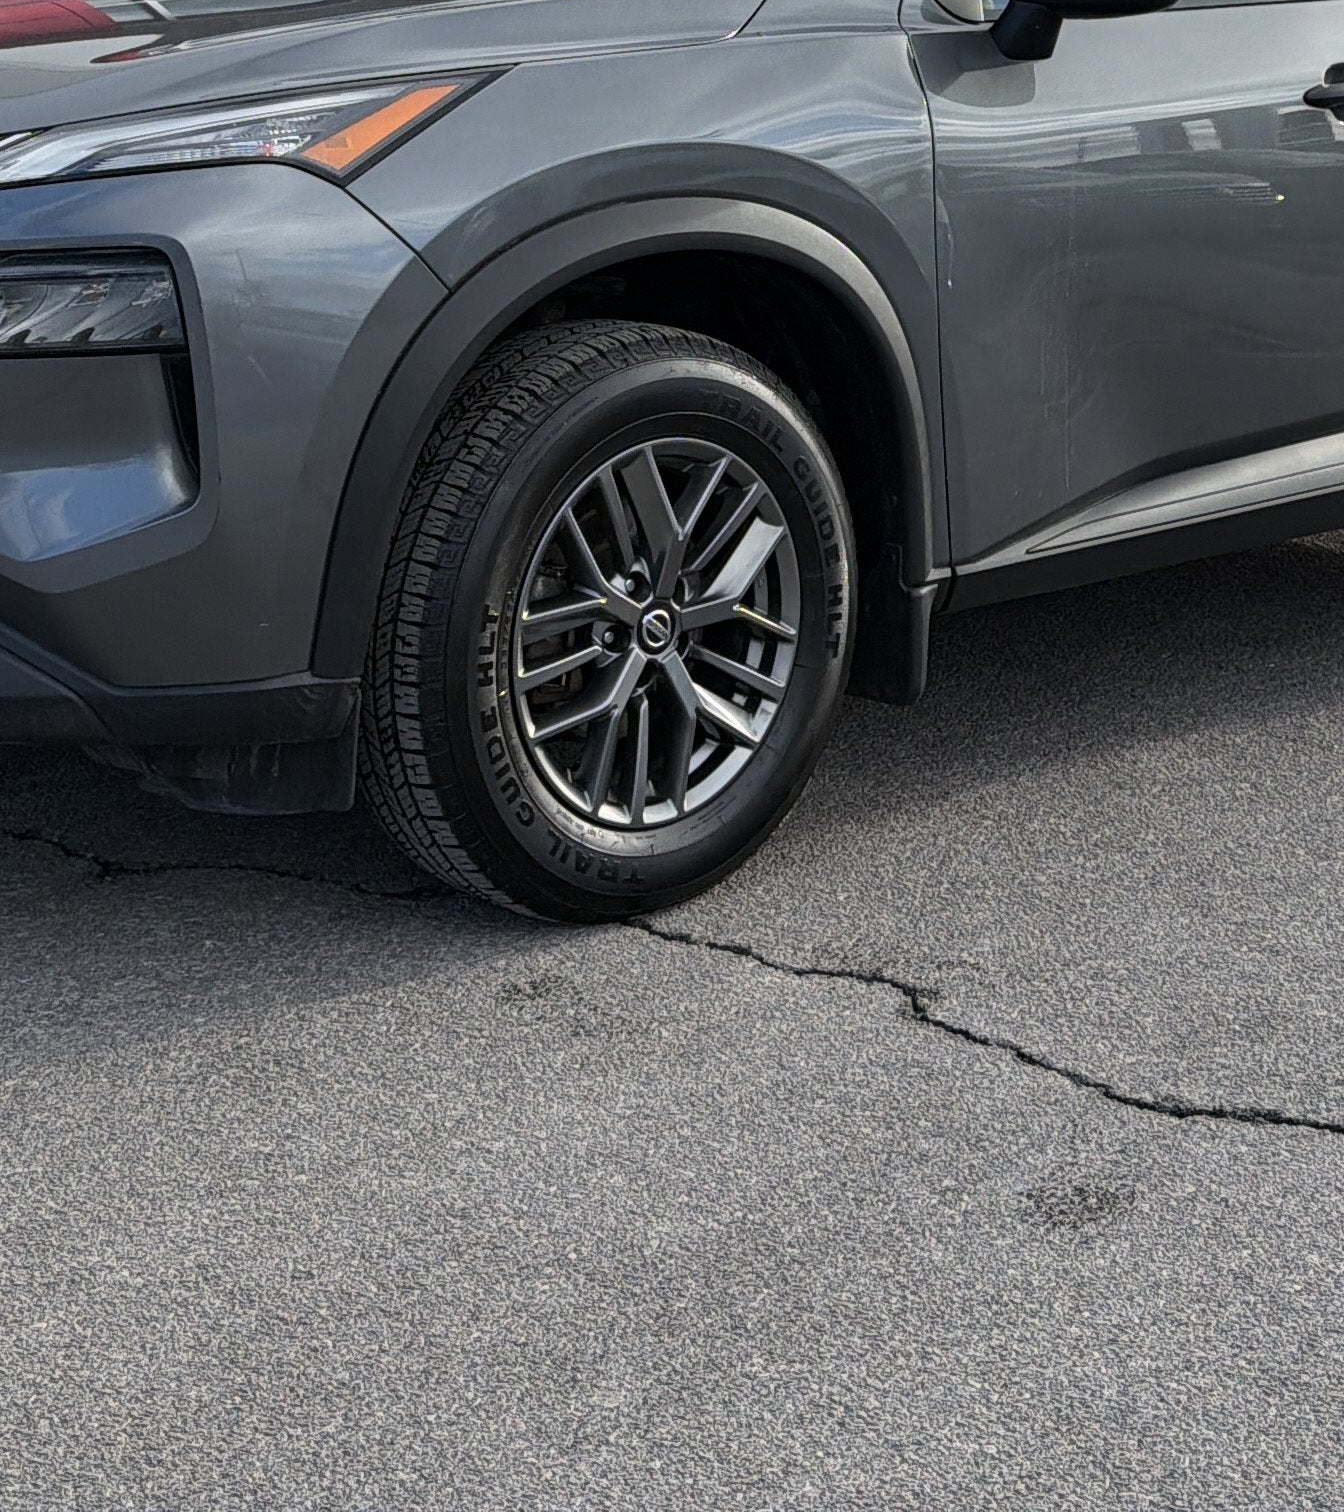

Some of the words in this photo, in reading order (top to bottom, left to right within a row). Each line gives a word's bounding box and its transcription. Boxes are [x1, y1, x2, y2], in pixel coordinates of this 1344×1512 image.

[793, 455, 840, 567] GUIDE
[477, 603, 500, 688] HLT
[480, 706, 536, 828] GUIDE
[548, 826, 645, 883] TRAIL
